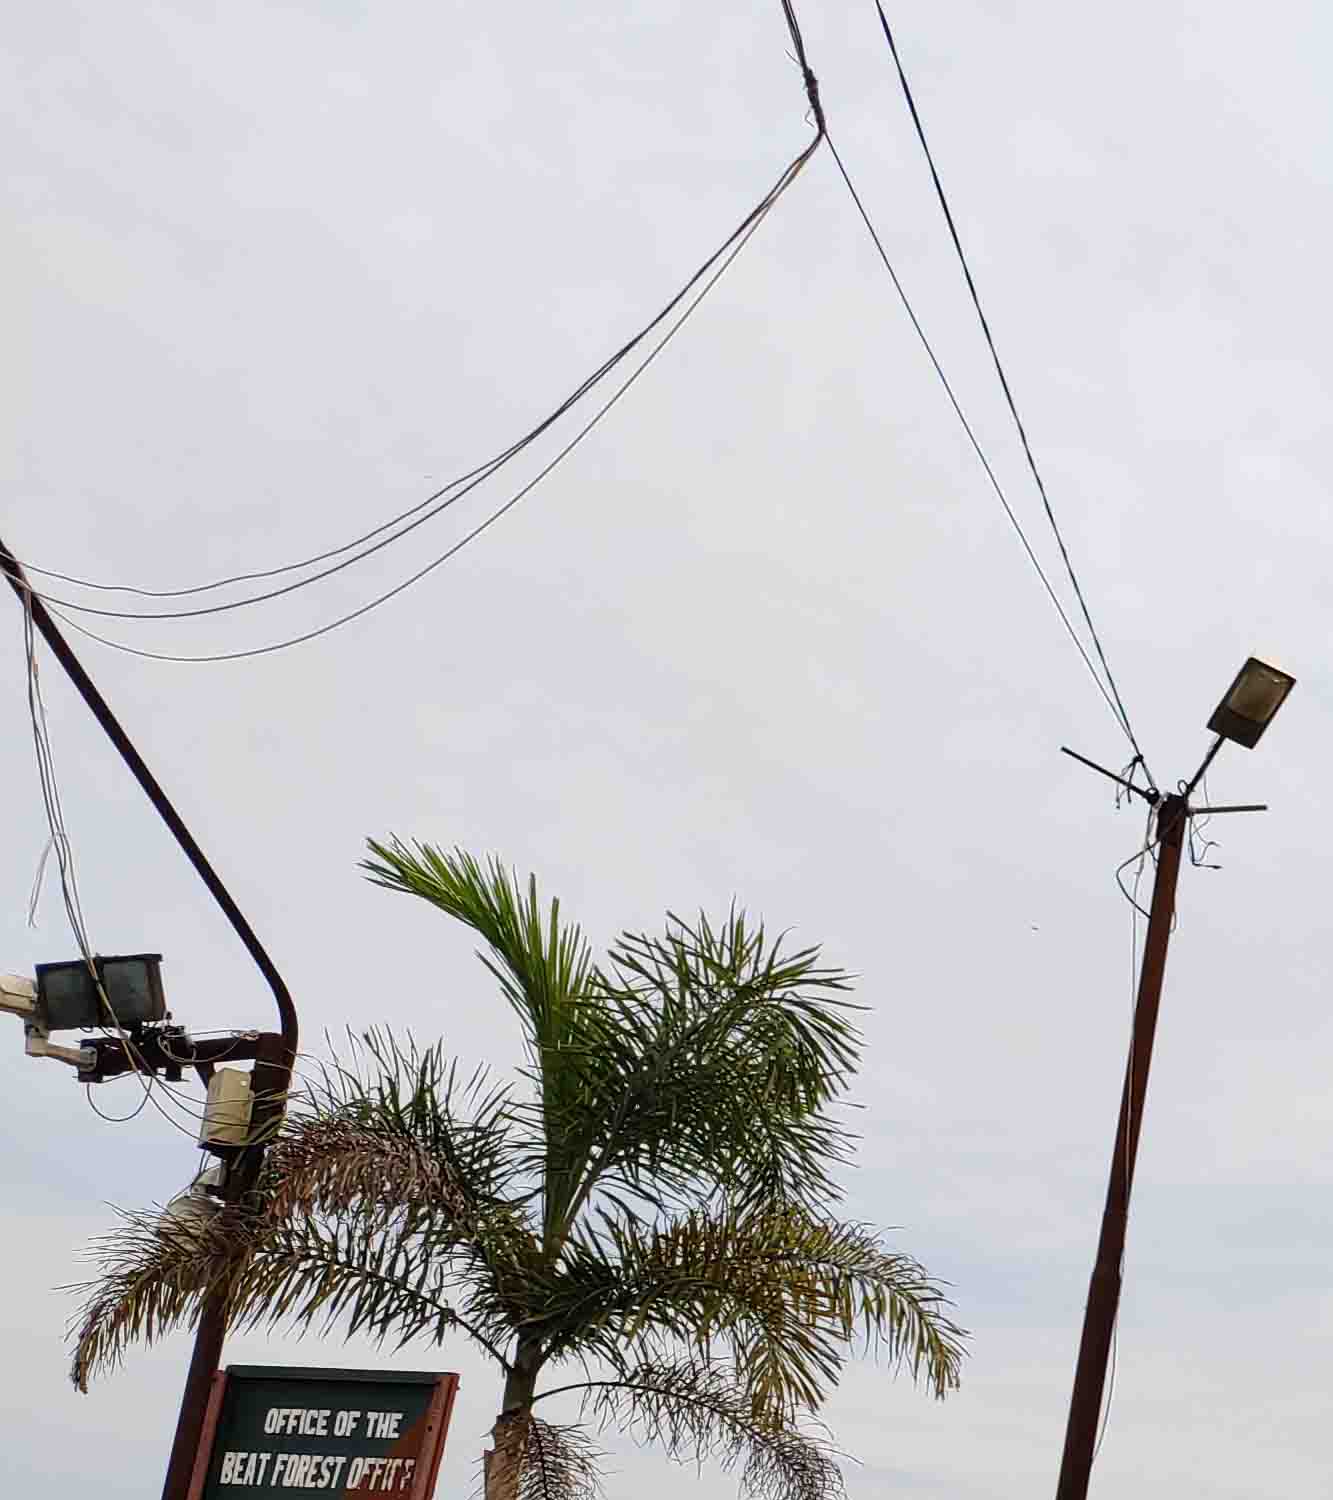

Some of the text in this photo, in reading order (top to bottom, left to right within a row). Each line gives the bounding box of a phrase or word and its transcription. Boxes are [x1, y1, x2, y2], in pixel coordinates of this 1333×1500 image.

[263, 1408, 404, 1439] OFFICE OF THE
[219, 1451, 271, 1486] BEAT
[270, 1453, 347, 1489] FOREST
